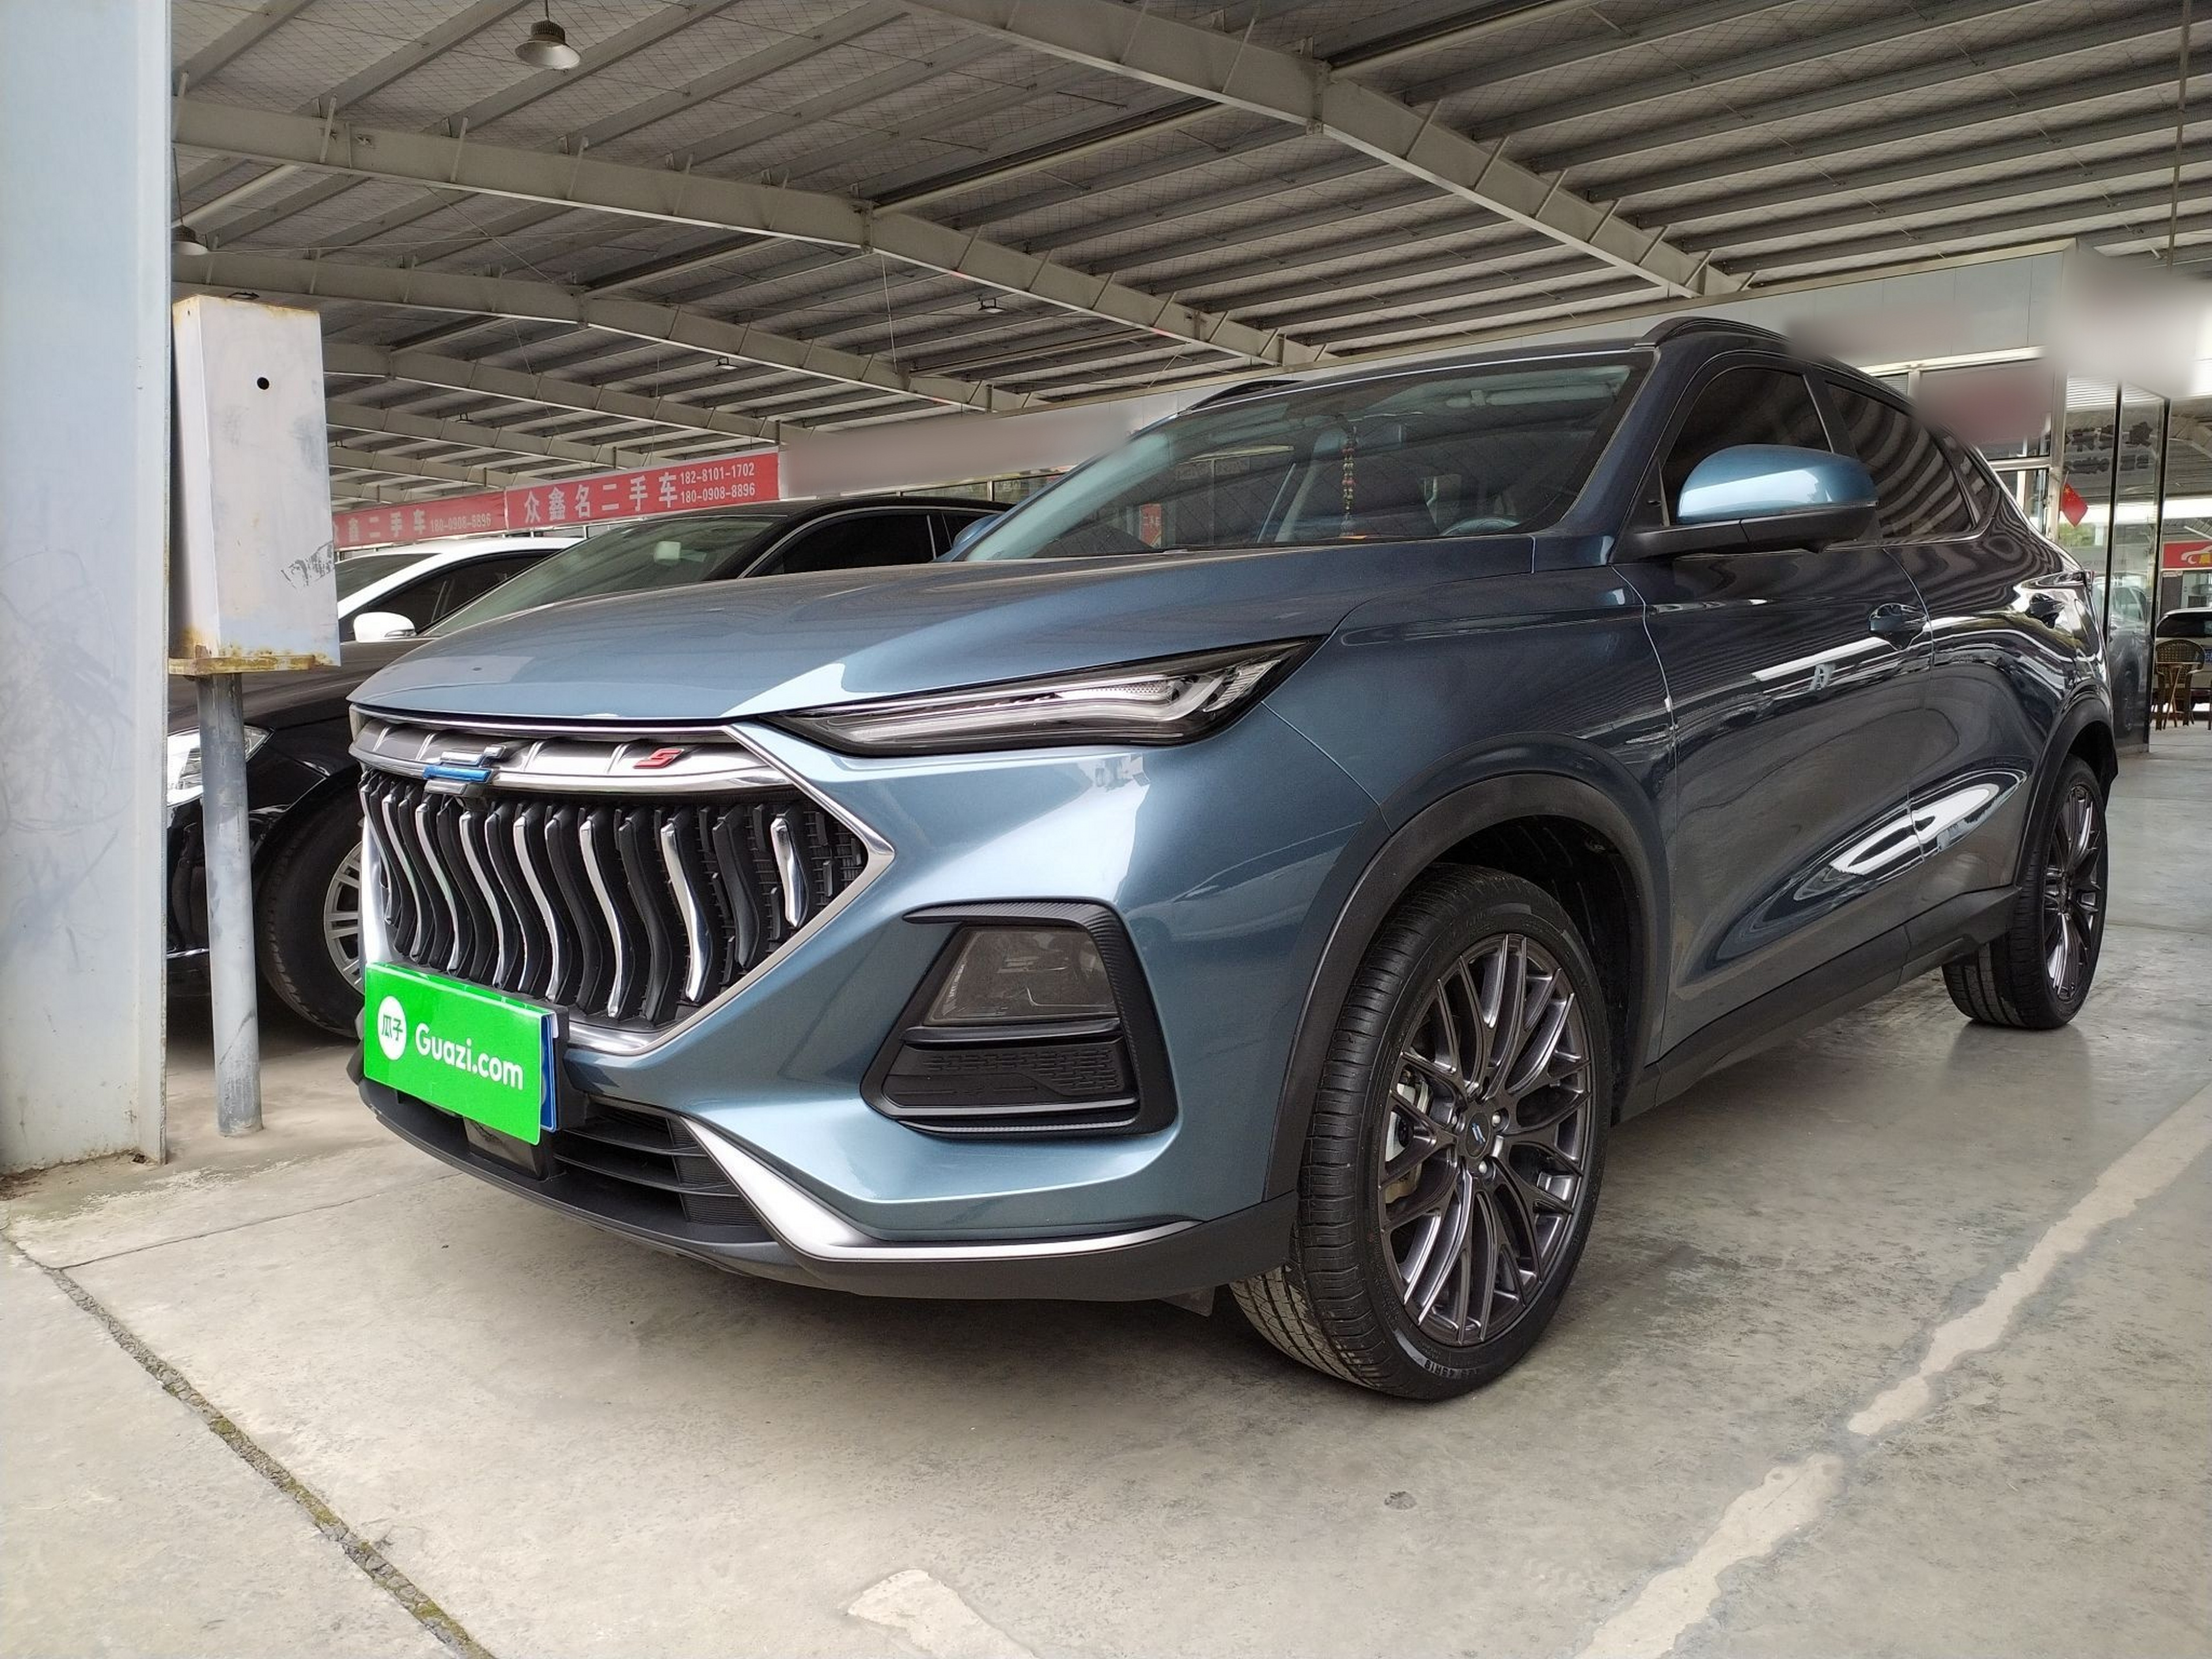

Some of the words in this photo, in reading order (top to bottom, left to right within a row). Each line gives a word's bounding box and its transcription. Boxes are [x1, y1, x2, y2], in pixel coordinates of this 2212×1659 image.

[680, 463, 755, 484] 182-8101-1702
[524, 472, 678, 522] 众鑫名二手车
[680, 483, 755, 504] 180-0908-8896
[382, 1014, 403, 1041] 瓜子
[415, 1022, 523, 1090] Guazi.com
